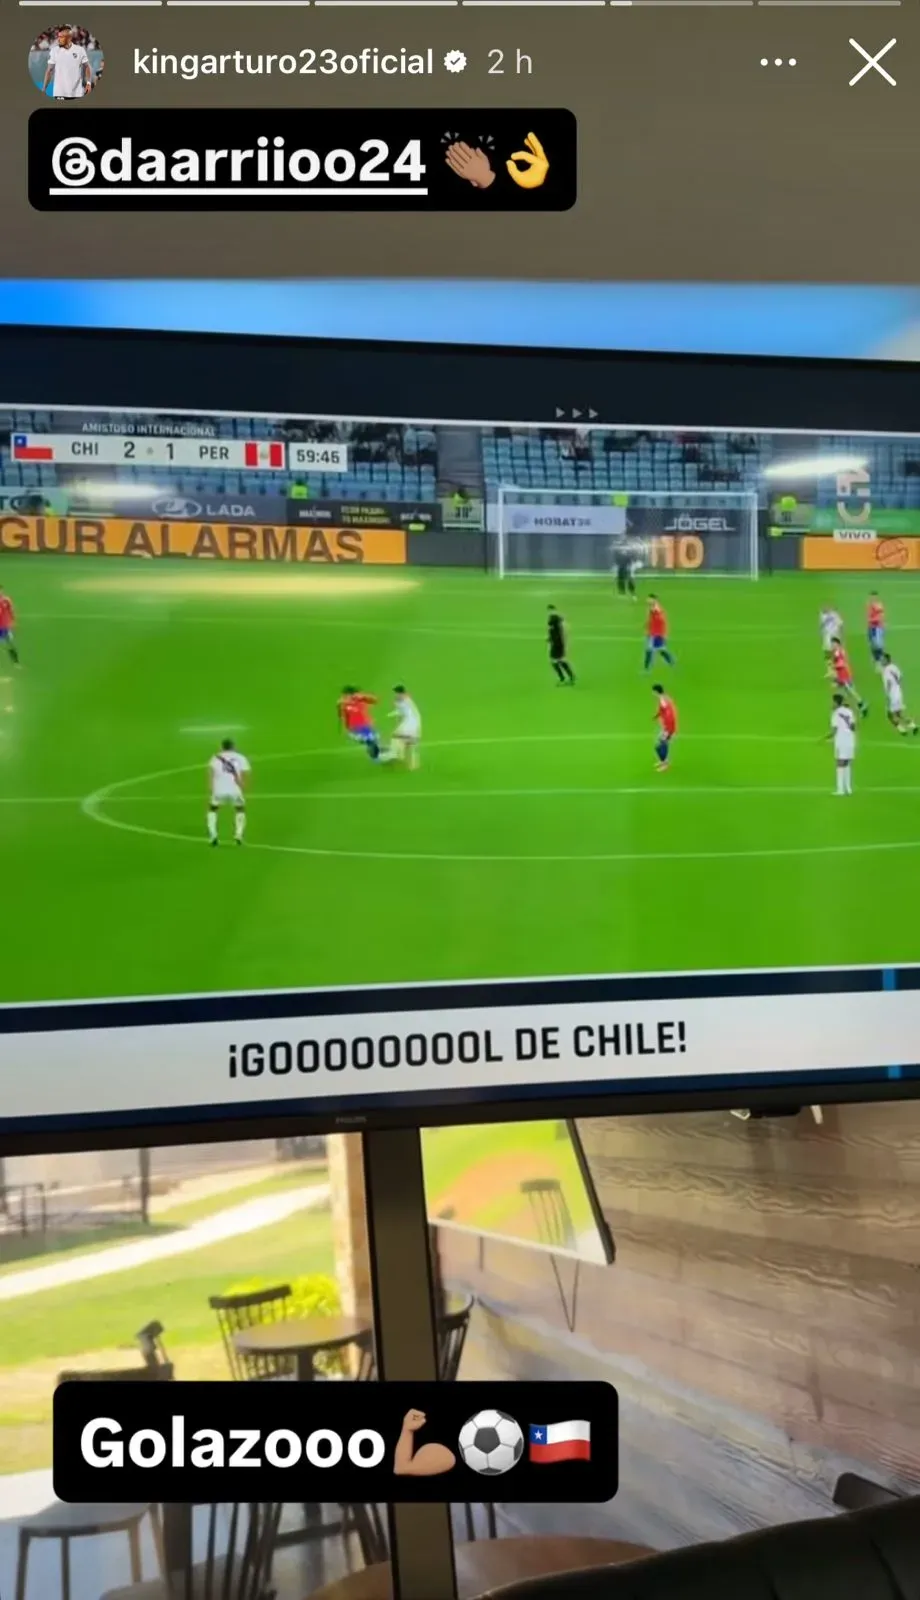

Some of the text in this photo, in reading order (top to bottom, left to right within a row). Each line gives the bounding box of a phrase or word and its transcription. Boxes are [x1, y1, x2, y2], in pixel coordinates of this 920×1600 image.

[82, 422, 216, 437] AMISTOSO INTERNACIONAL
[71, 441, 230, 461] CHI 2 1 PER
[206, 503, 256, 517] LADA
[122, 522, 365, 564] ALARMAS
[839, 531, 872, 542] VIVO
[515, 1026, 560, 1061] DE
[573, 1020, 687, 1057] CHILE!
